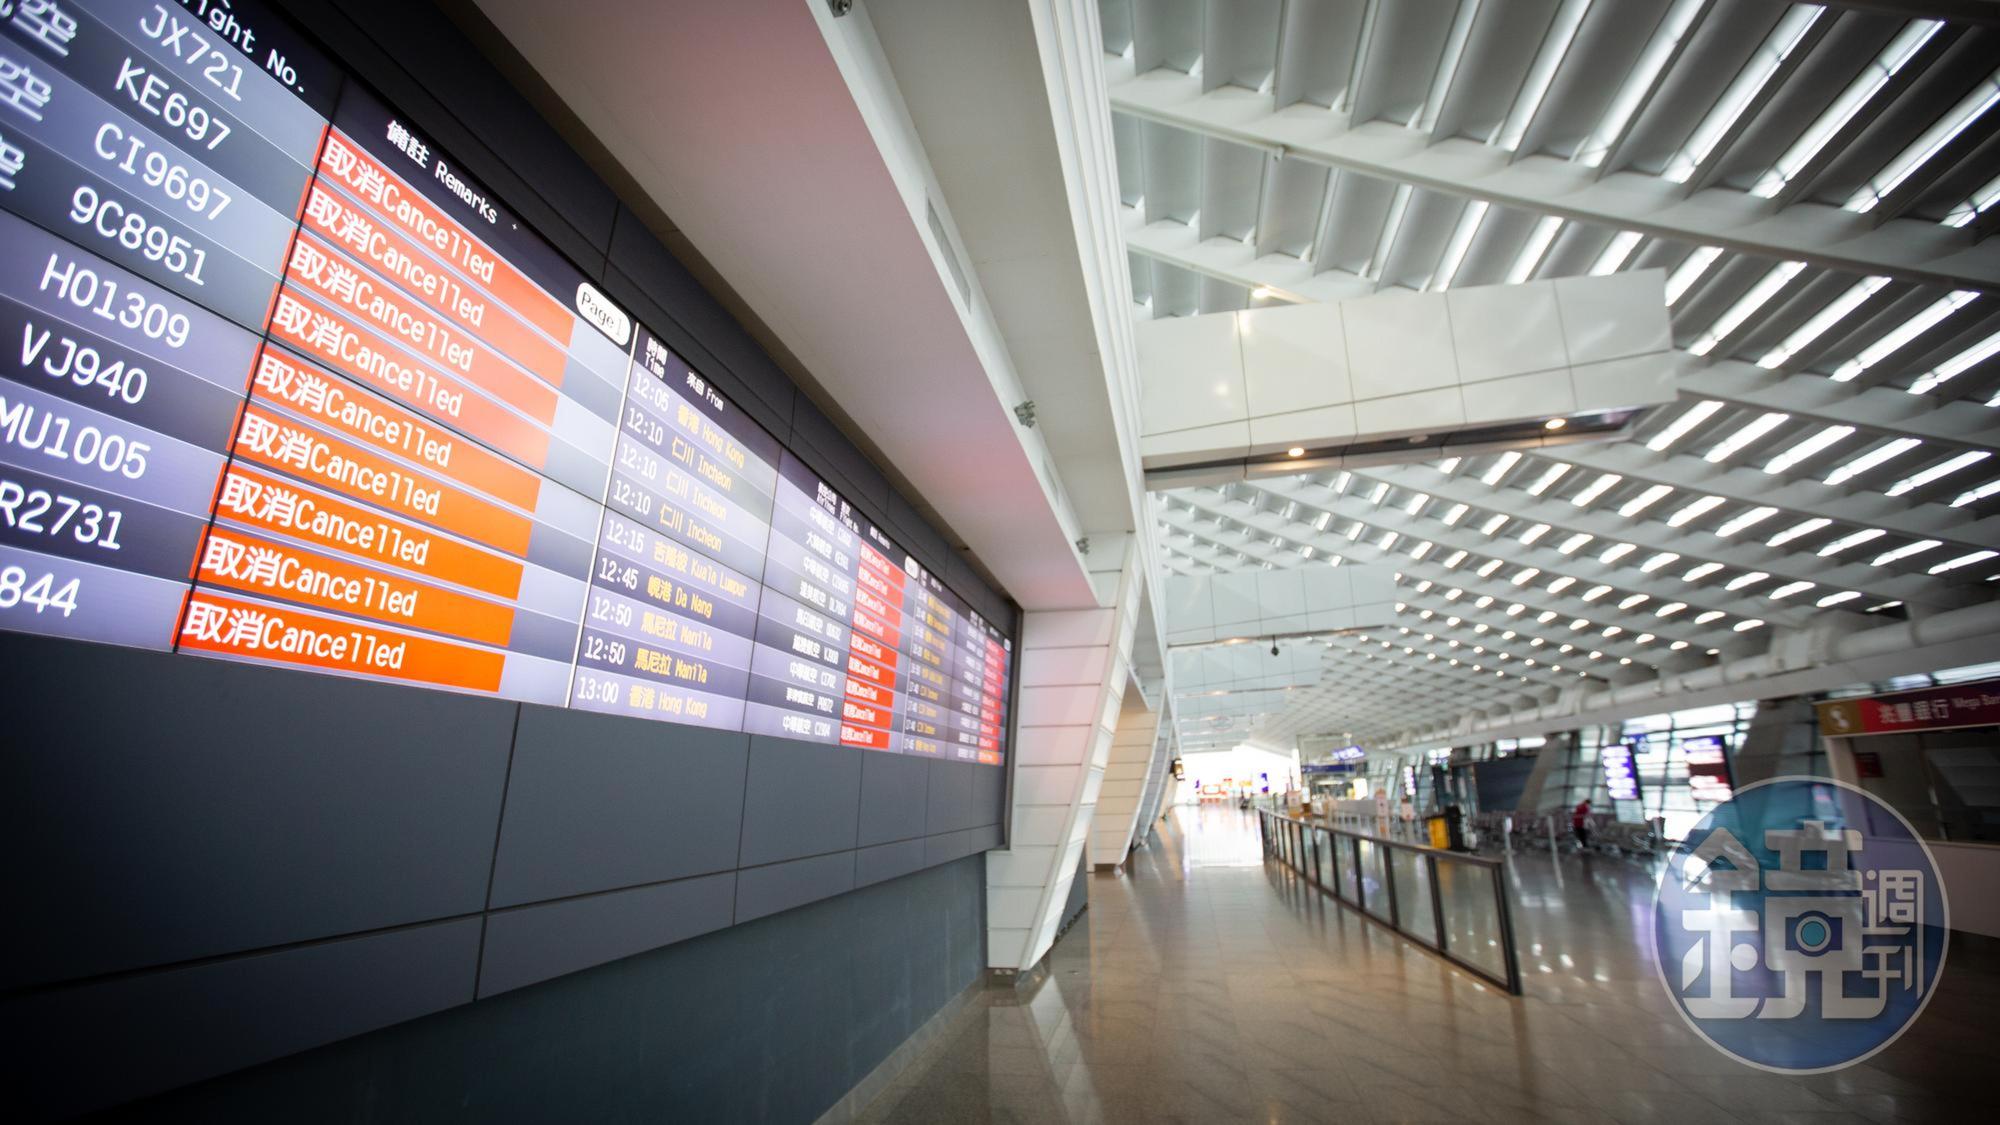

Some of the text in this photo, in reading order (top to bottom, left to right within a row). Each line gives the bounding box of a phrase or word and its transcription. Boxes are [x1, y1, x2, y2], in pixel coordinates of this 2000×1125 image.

[184, 0, 304, 93] ight No.
[140, 4, 495, 284] JX721 取消Cancelled
[115, 57, 232, 151] KE697
[306, 186, 485, 328] 取消Cancelled
[435, 160, 497, 225] Remarks
[94, 122, 232, 221] CI9697
[290, 239, 475, 373] 取消Cancelled
[69, 186, 464, 418] 9C8951 取消Cancelled
[21, 321, 441, 516] VJ940 取消Cancelled
[255, 354, 452, 468] 取消Cancelled
[633, 372, 669, 412] 12:05
[706, 388, 724, 411] From
[0, 396, 430, 566] MU1005 取消Cancelled
[620, 443, 727, 520] 12:10 仁川 Incheon
[626, 407, 732, 491] 12:10 仁川 Incheon
[606, 519, 645, 553] 12:15
[691, 557, 717, 586] Kuala
[613, 479, 721, 552] 12:10 仁川 Incheon
[201, 536, 418, 617] 取消Cancelled
[599, 557, 639, 590] 12:45
[675, 586, 688, 609] Da
[691, 593, 713, 619] Nang
[0, 566, 406, 670] 844 取消Cancelled
[592, 596, 632, 628] 12:50
[680, 625, 712, 651] Manila
[577, 676, 619, 704] 13:00
[658, 691, 682, 714] Hong
[685, 696, 708, 719] Kong
[584, 635, 708, 684] 12:50 馬尼拉 Manila
